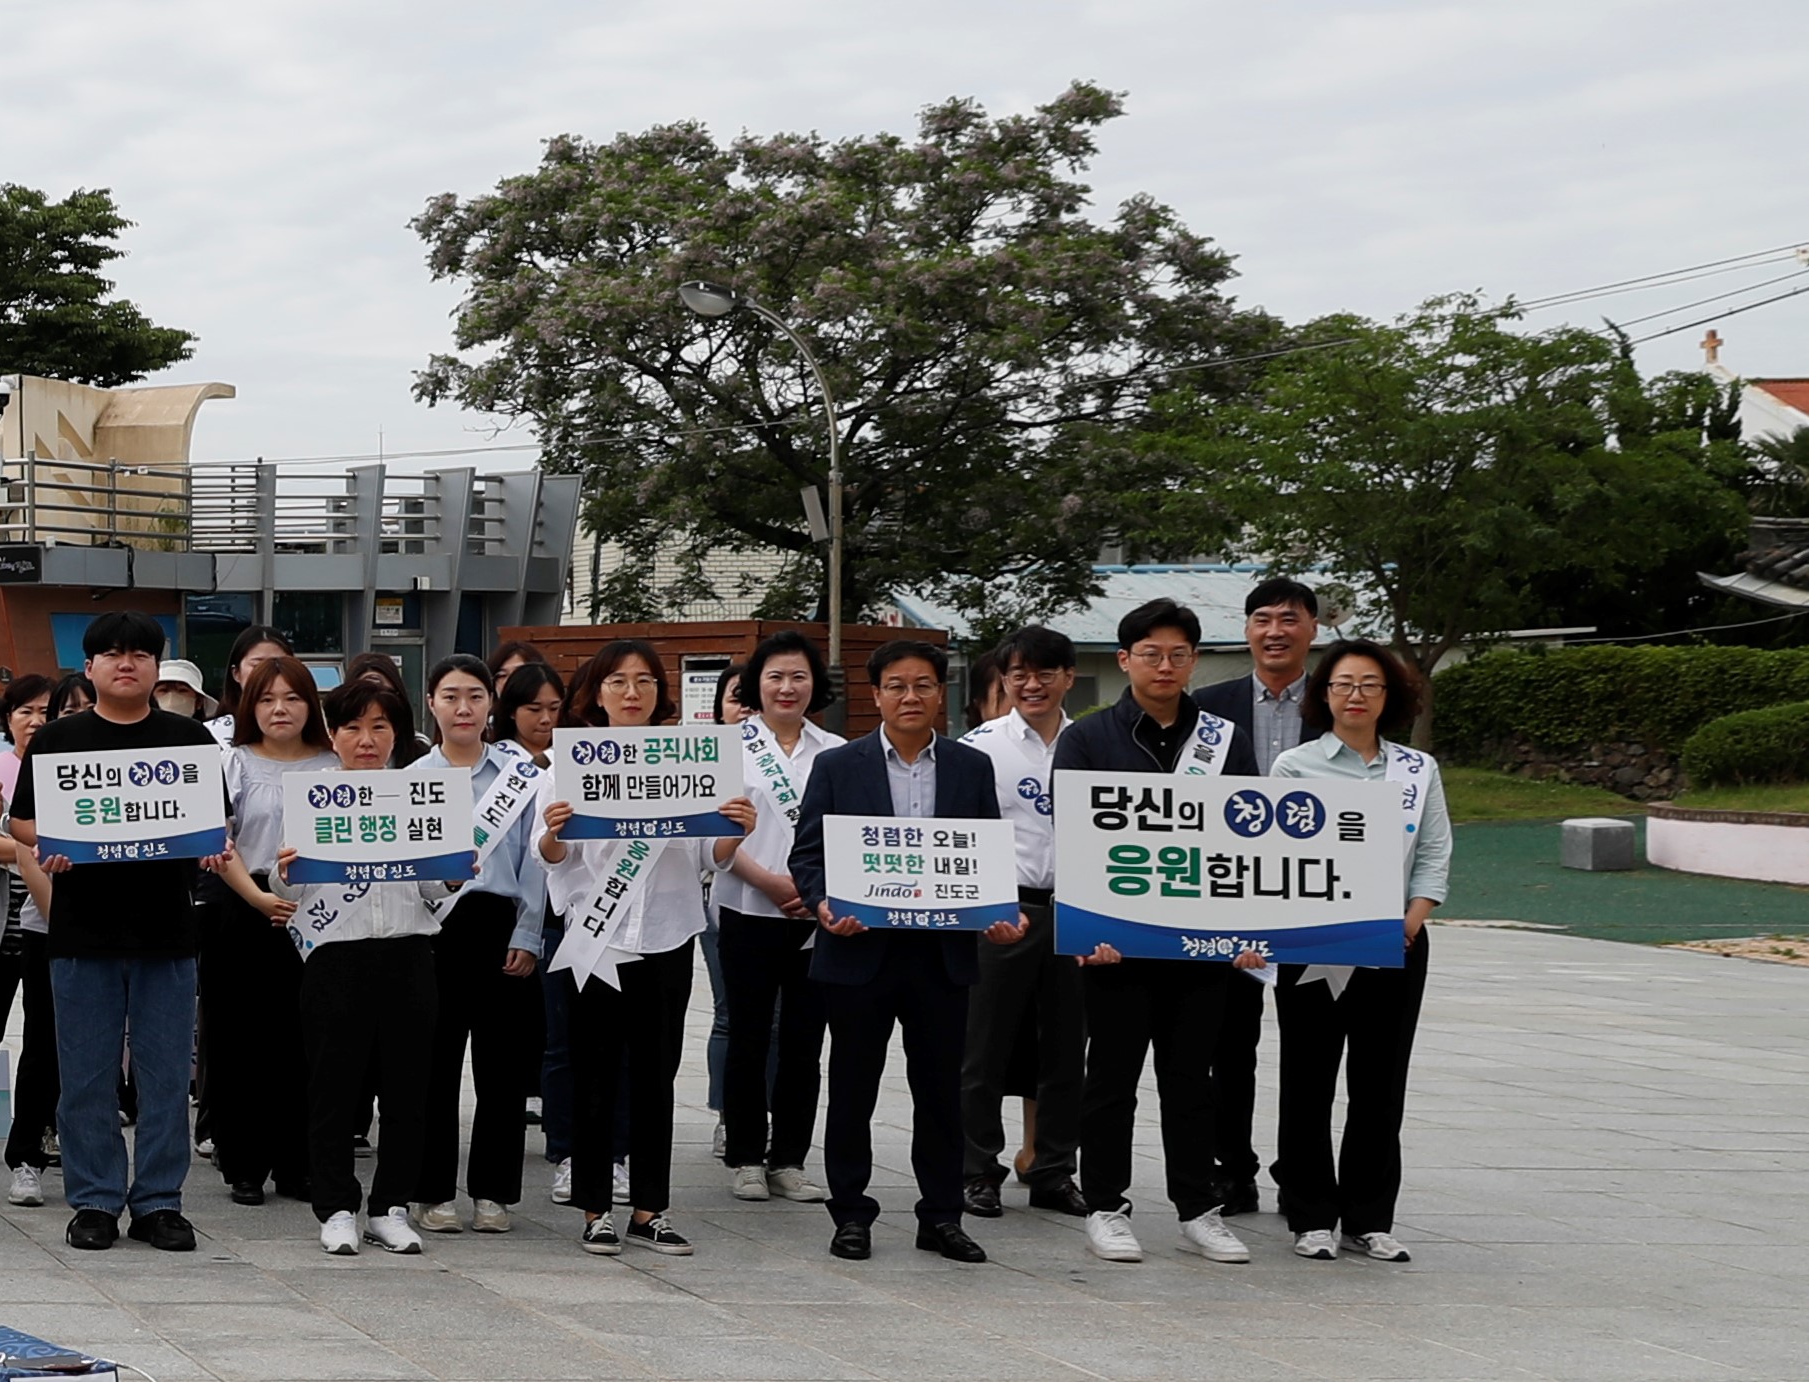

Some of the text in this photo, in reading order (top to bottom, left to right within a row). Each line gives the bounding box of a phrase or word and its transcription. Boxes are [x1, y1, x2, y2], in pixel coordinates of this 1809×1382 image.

[643, 736, 719, 765] 공직사회
[56, 763, 122, 791] 당신의
[582, 774, 716, 801] 함께 만들어가요
[409, 781, 446, 806] 진도
[74, 796, 186, 826] 응원합니다.
[1090, 785, 1204, 833] 당신의
[314, 814, 443, 845] 클린 행정 실현
[861, 826, 976, 849] 청렴한 오늘!
[862, 853, 978, 876] 떳떳한 내일!
[1105, 843, 1353, 902] 응원합니다.
[864, 881, 913, 899] Jindo
[934, 884, 980, 900] 진도군
